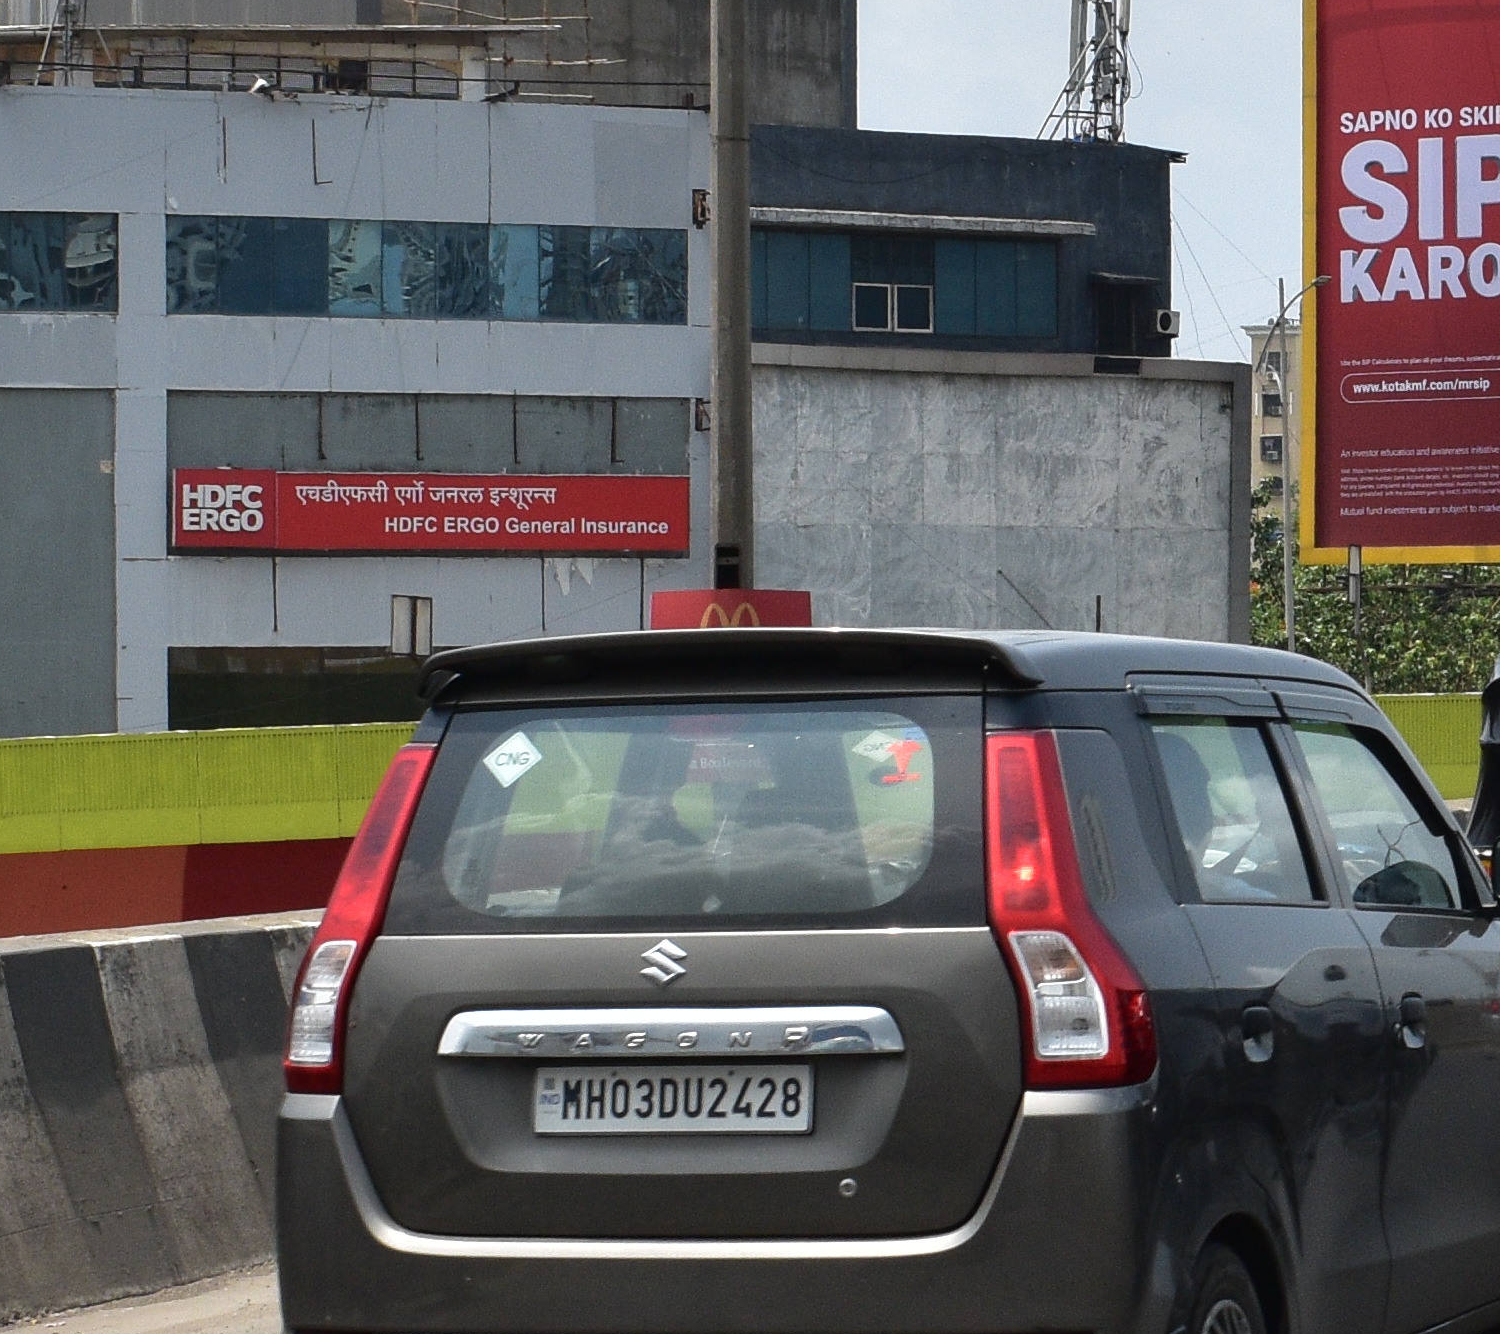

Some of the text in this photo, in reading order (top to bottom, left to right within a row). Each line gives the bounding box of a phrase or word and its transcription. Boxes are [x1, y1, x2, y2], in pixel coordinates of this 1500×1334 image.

[1340, 108, 1417, 133] SAPNO
[1424, 108, 1452, 129] KO
[1352, 376, 1490, 394] www.kotakmf.com/mrsip
[182, 484, 263, 509] HDFC
[295, 480, 556, 511] एचडीएफसी एर्गो जनरल इन्शूरन्स
[182, 509, 263, 533] ERGO
[1365, 505, 1383, 515] fund
[1383, 504, 1427, 514] investments
[1441, 503, 1468, 515] subject
[384, 515, 669, 535] HDFC ERGO General Insurance
[494, 751, 530, 767] CNG
[561, 1077, 802, 1120] MH03DU2428
